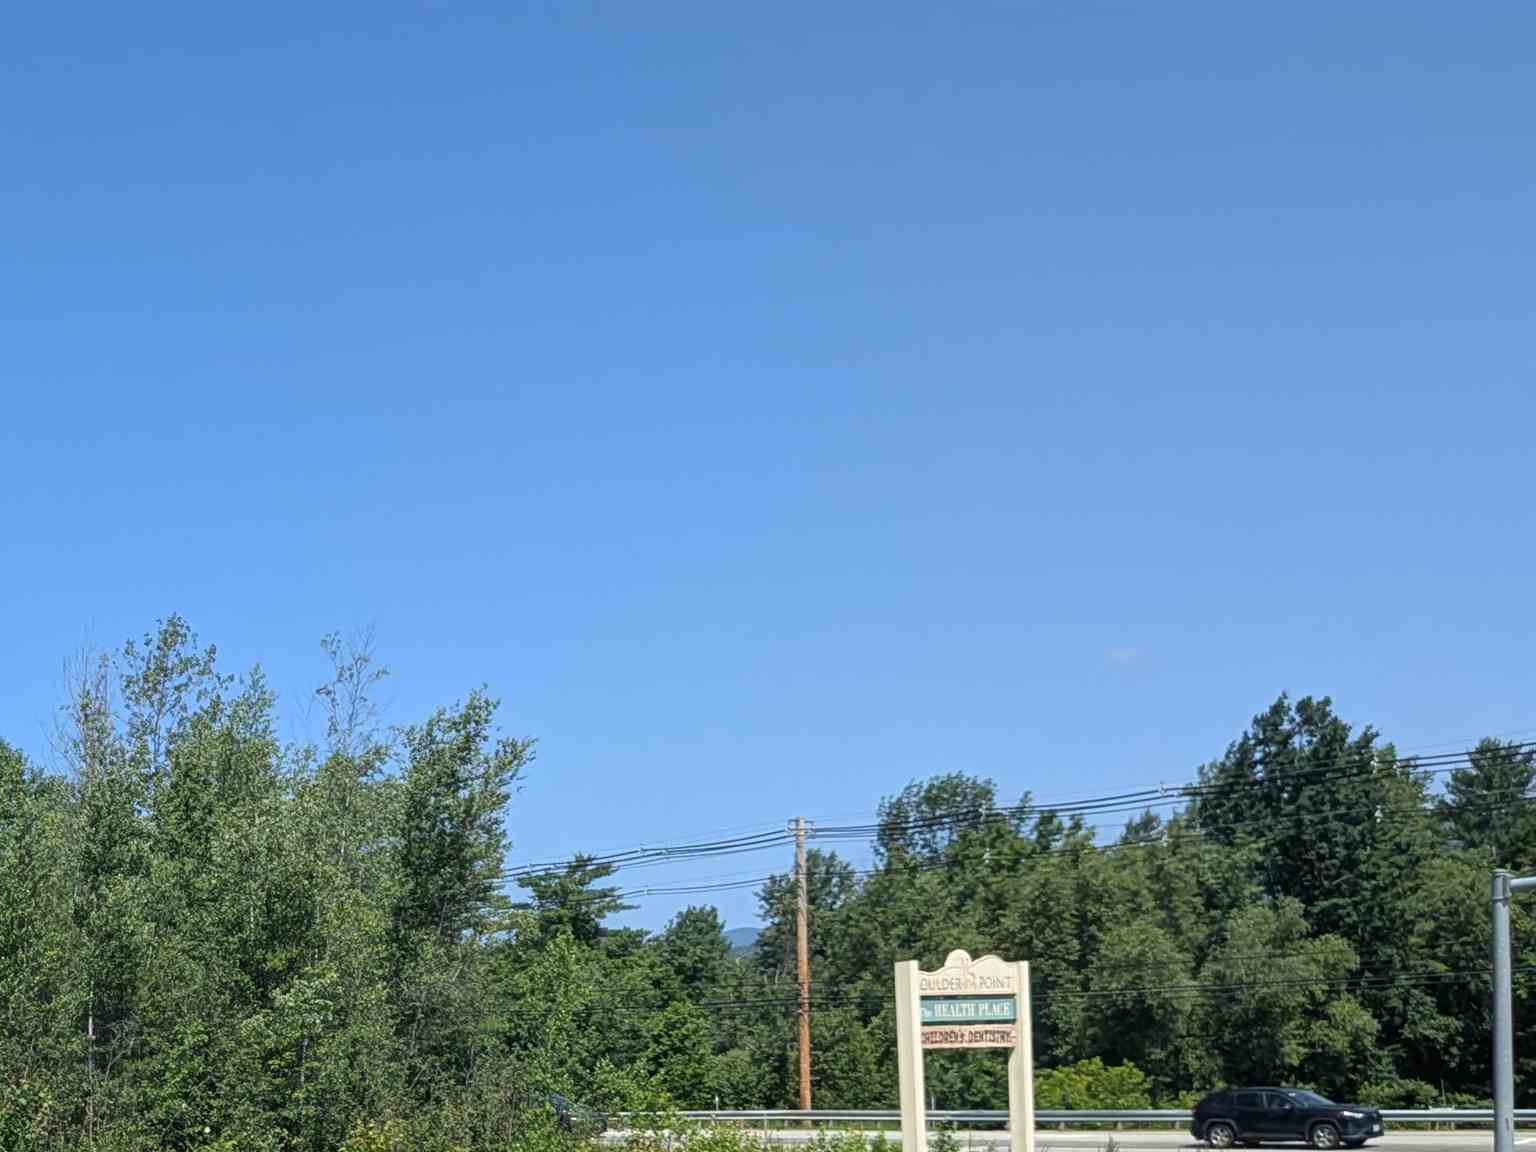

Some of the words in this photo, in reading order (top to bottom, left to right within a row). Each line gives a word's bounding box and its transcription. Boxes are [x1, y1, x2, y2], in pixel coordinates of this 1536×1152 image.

[979, 976, 1011, 989] POINT
[934, 1003, 975, 1017] HEALTH
[978, 1002, 1009, 1017] PLACE
[968, 1030, 1010, 1044] DENTISTRY
